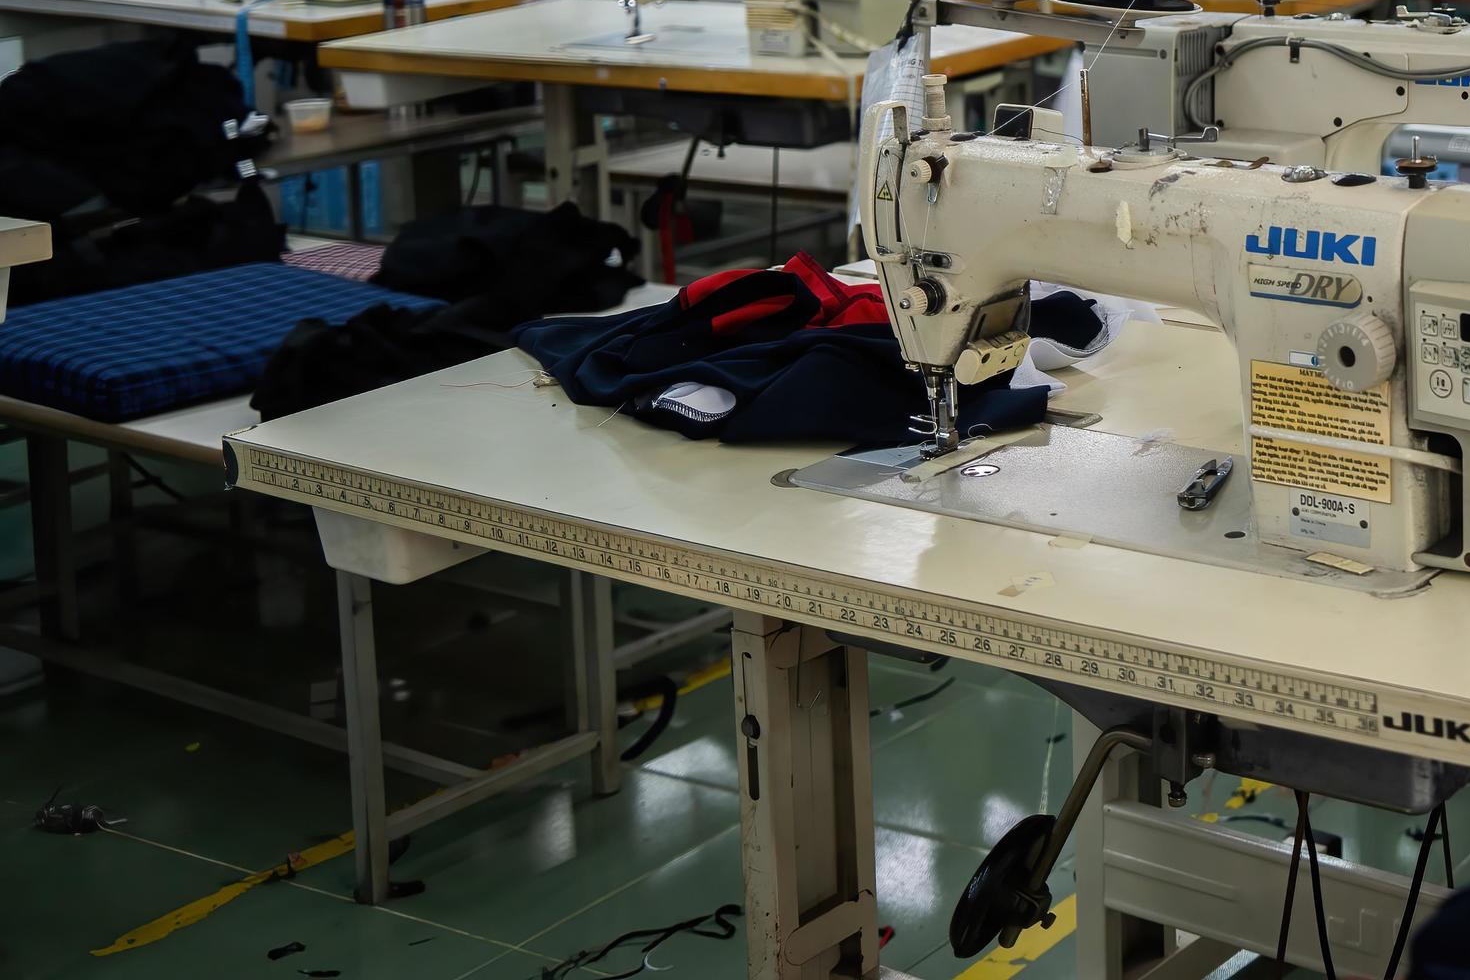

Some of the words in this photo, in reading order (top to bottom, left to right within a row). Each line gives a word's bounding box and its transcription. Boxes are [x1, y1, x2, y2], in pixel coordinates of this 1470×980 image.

[1246, 226, 1376, 266] JUKI
[1254, 278, 1275, 286] HIGH
[1276, 280, 1301, 289] SPEED
[1288, 273, 1353, 301] DRY
[1300, 494, 1355, 515] DDL-900A-S
[492, 527, 502, 539] 10
[518, 534, 528, 545] 11
[546, 540, 558, 552] 12
[573, 547, 584, 559] 13
[600, 554, 612, 565] 14
[629, 560, 641, 572] 15
[657, 567, 670, 579] 16
[686, 574, 699, 586] 17
[716, 581, 729, 593] 18
[747, 588, 760, 600] 19
[809, 602, 822, 614] 21
[841, 608, 856, 622] 22
[873, 615, 889, 629] 23
[907, 623, 922, 637] 24
[940, 630, 956, 644] 25
[975, 638, 990, 652] 26
[1009, 645, 1025, 659] 27
[1046, 653, 1061, 667] 28
[1082, 661, 1098, 674] 29
[1119, 668, 1135, 682] 30
[1157, 676, 1174, 690] 31
[1196, 684, 1214, 699] 32
[1235, 693, 1254, 707] 33
